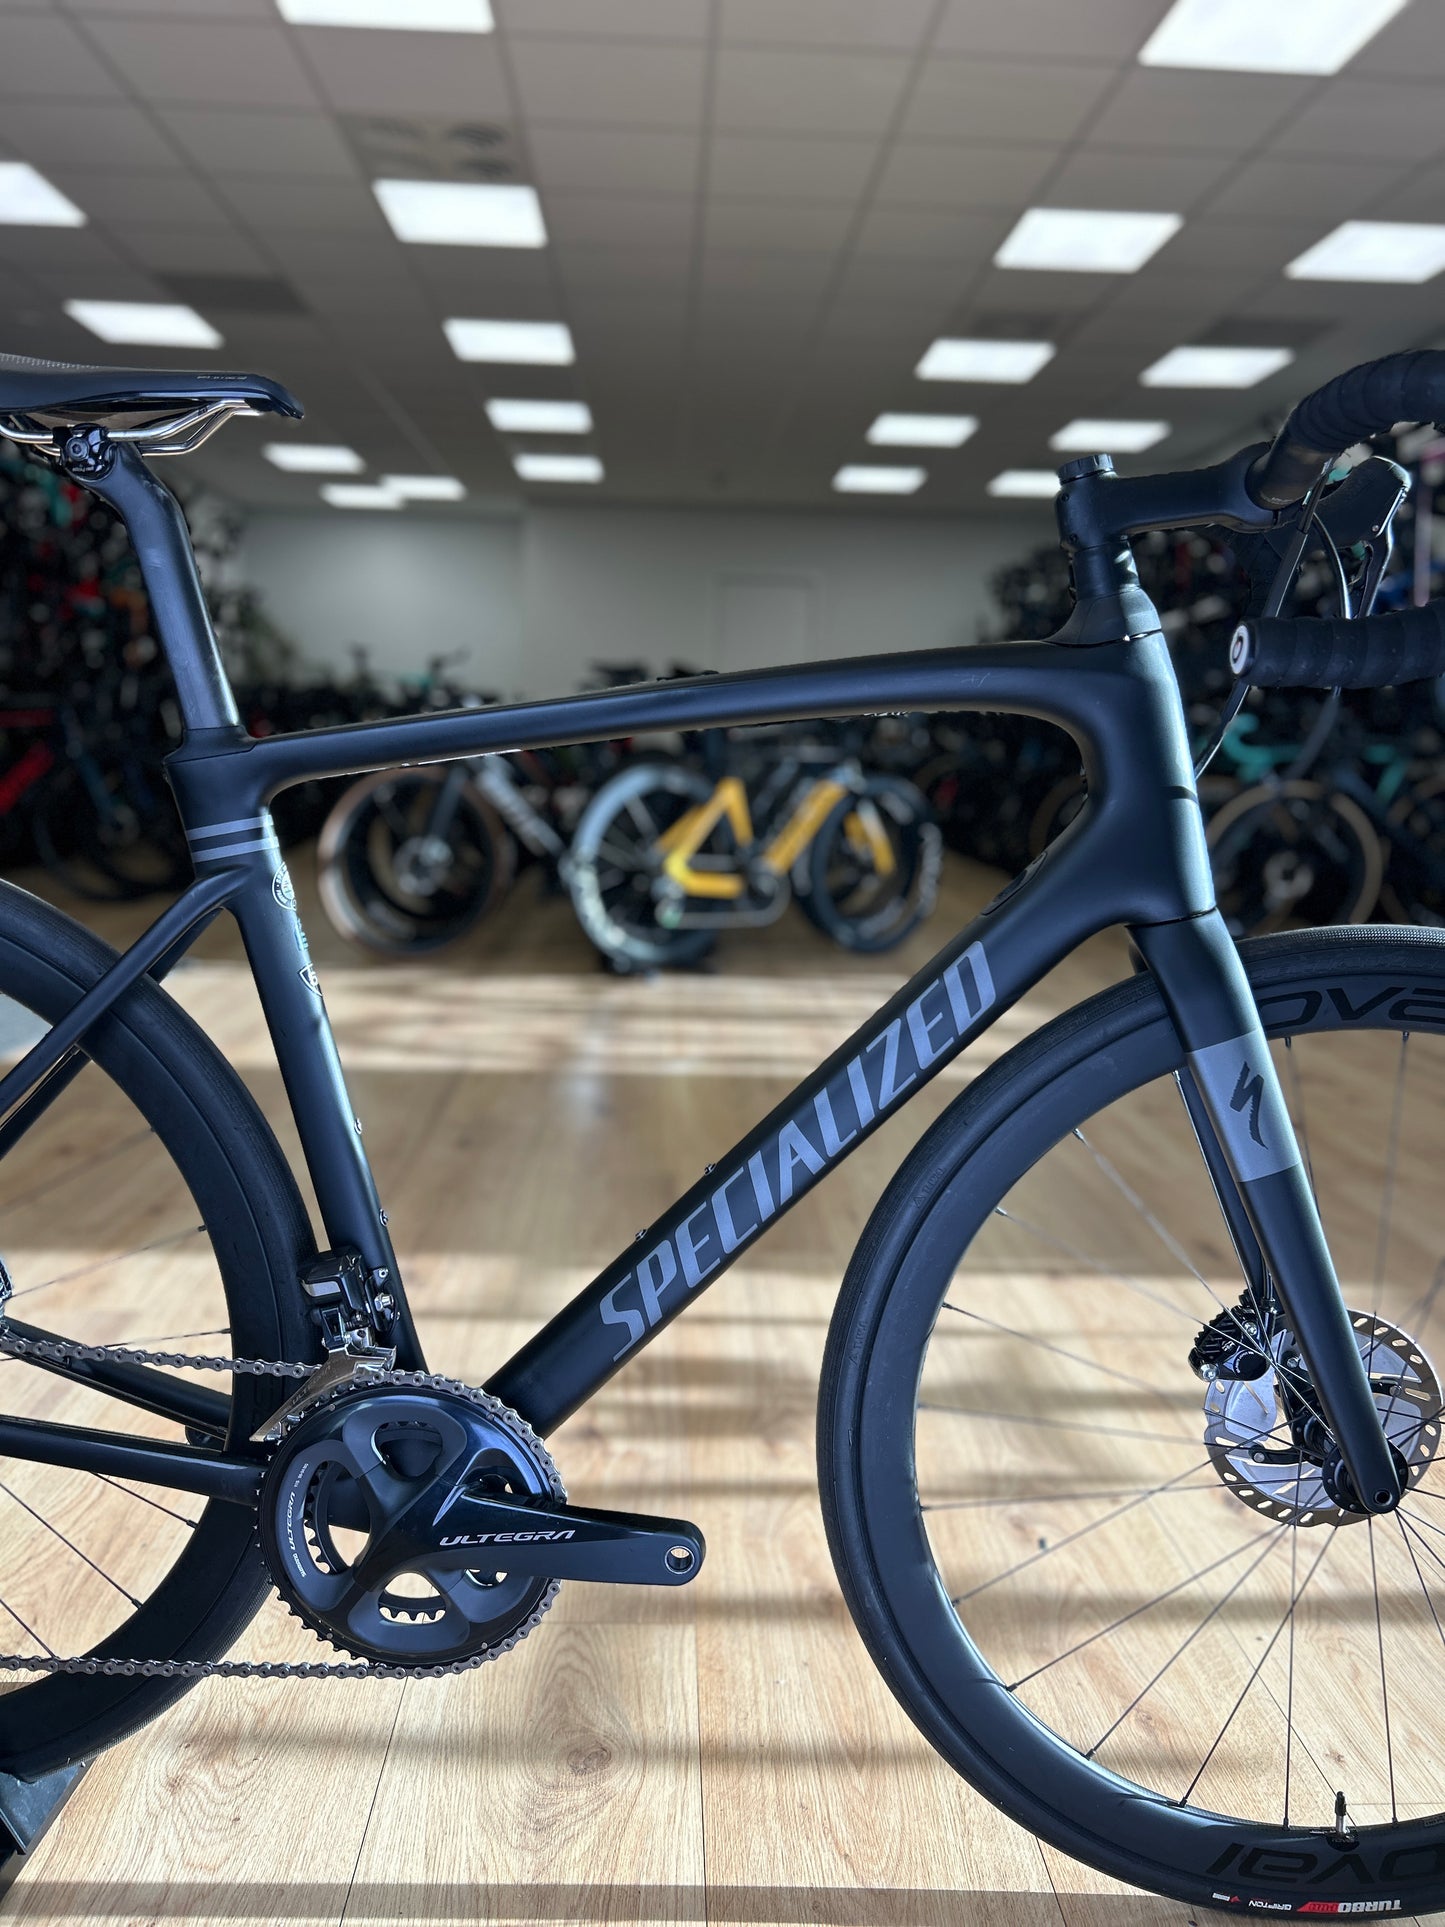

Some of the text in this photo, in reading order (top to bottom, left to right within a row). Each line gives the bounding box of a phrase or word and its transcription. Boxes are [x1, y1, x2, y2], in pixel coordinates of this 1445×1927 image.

[600, 941, 996, 1362] SPECIALIZED
[285, 1491, 296, 1551] ULTEGRA
[439, 1529, 576, 1546] ULTEGRA
[1248, 1899, 1292, 1912] GRIPTON
[1337, 1899, 1402, 1914] TURBO
